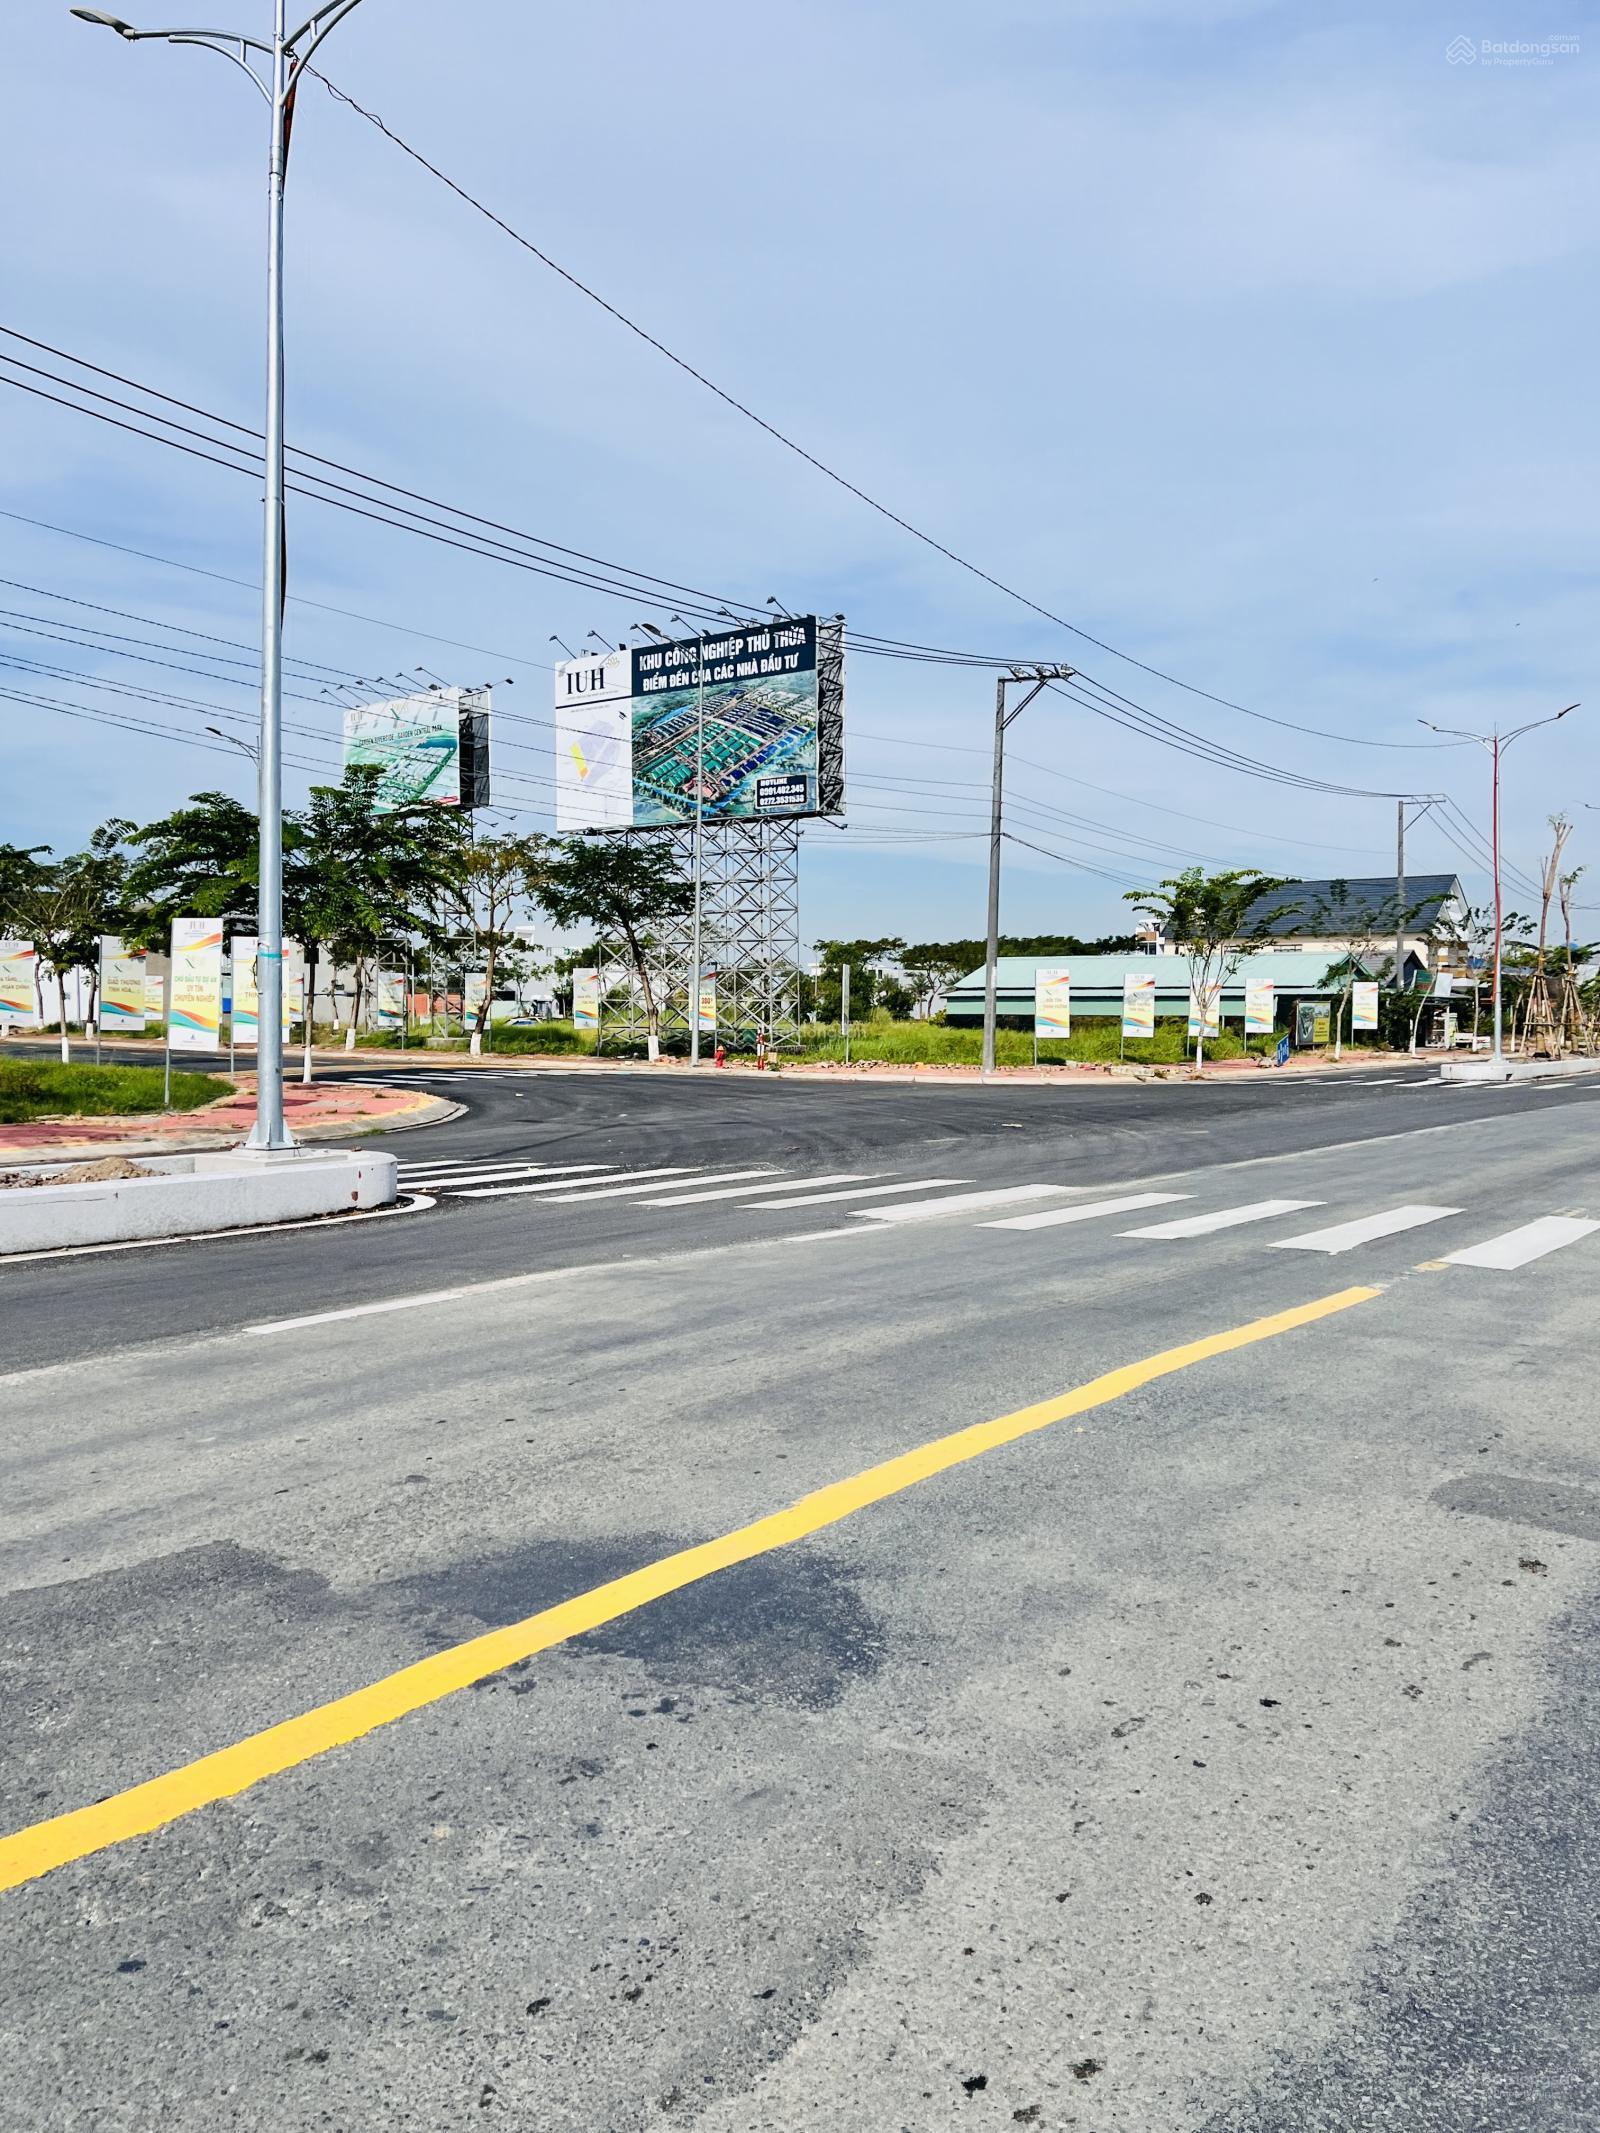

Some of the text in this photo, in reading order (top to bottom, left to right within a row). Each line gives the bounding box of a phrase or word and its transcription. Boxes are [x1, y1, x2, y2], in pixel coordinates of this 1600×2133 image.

[639, 653, 662, 671] KHU
[664, 645, 697, 667] CÔNG
[700, 636, 744, 661] NGHIỆP
[746, 627, 771, 653] THỦ
[566, 667, 605, 694] IUH
[642, 671, 667, 692] ĐIỂM
[669, 668, 690, 688] ĐẾN
[714, 662, 735, 681] CÁC
[736, 657, 758, 677] NHÀ
[760, 653, 782, 673] ĐẦU
[783, 652, 799, 670] TƯ
